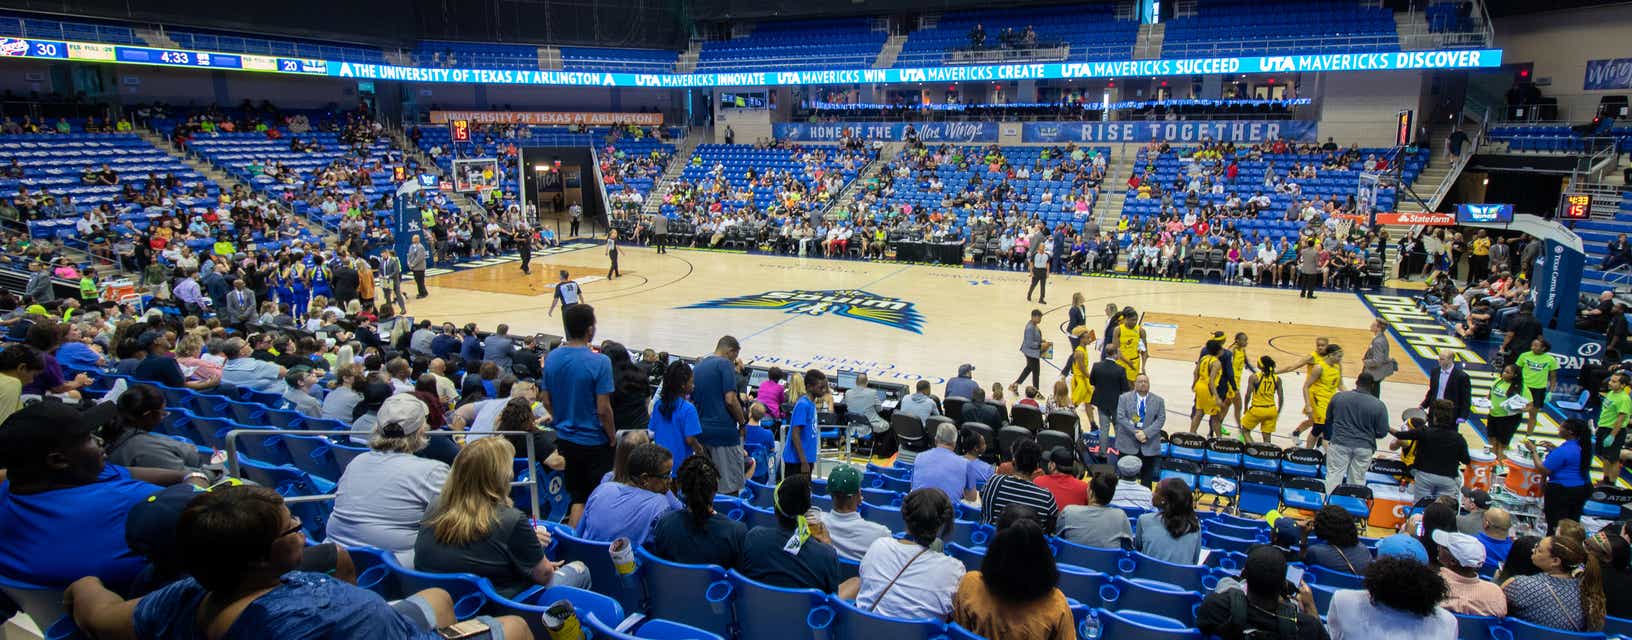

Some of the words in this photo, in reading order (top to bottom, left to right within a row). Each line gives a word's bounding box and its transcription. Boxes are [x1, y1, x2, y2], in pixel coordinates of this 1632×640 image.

[36, 43, 57, 56] 30
[161, 51, 189, 64] 4:33
[1259, 56, 1296, 72] UTA
[1300, 53, 1389, 70] MAVERICKS
[1396, 51, 1480, 68] DISCOVER
[284, 60, 298, 72] 20
[1061, 64, 1092, 77] UTA
[1094, 60, 1170, 76] MAVERICKS
[1176, 58, 1240, 73] SUCCEED
[353, 64, 376, 78] THE
[380, 65, 449, 82] UNIVERSITY
[453, 69, 469, 82] OF
[472, 70, 512, 83] TEXAS
[516, 71, 530, 84] AT
[534, 71, 600, 86] ARLINGTON
[634, 74, 661, 86] UTA
[662, 74, 714, 86] MAVERICKS
[718, 73, 766, 86] INNOVATE
[777, 72, 800, 84] UTA
[802, 70, 860, 84] MAVERICKS
[864, 69, 886, 82] WIN
[900, 68, 926, 82] UTA
[928, 66, 992, 81] MAVERICKS
[998, 64, 1044, 78] CREATE
[443, 112, 513, 122] UNIVERSITY
[518, 112, 532, 122] OF
[535, 113, 570, 122] TEXAS
[575, 113, 586, 122] AT
[592, 113, 652, 123] ARLINGTON
[457, 128, 466, 140] 15
[810, 126, 842, 138] HOME
[848, 126, 861, 138] OF
[868, 127, 892, 138] THE
[945, 122, 982, 142] Wings
[1082, 124, 1134, 141] RISE
[1150, 123, 1280, 141] TOGETHER
[1568, 196, 1588, 205] 4:33
[1570, 205, 1584, 216] 15
